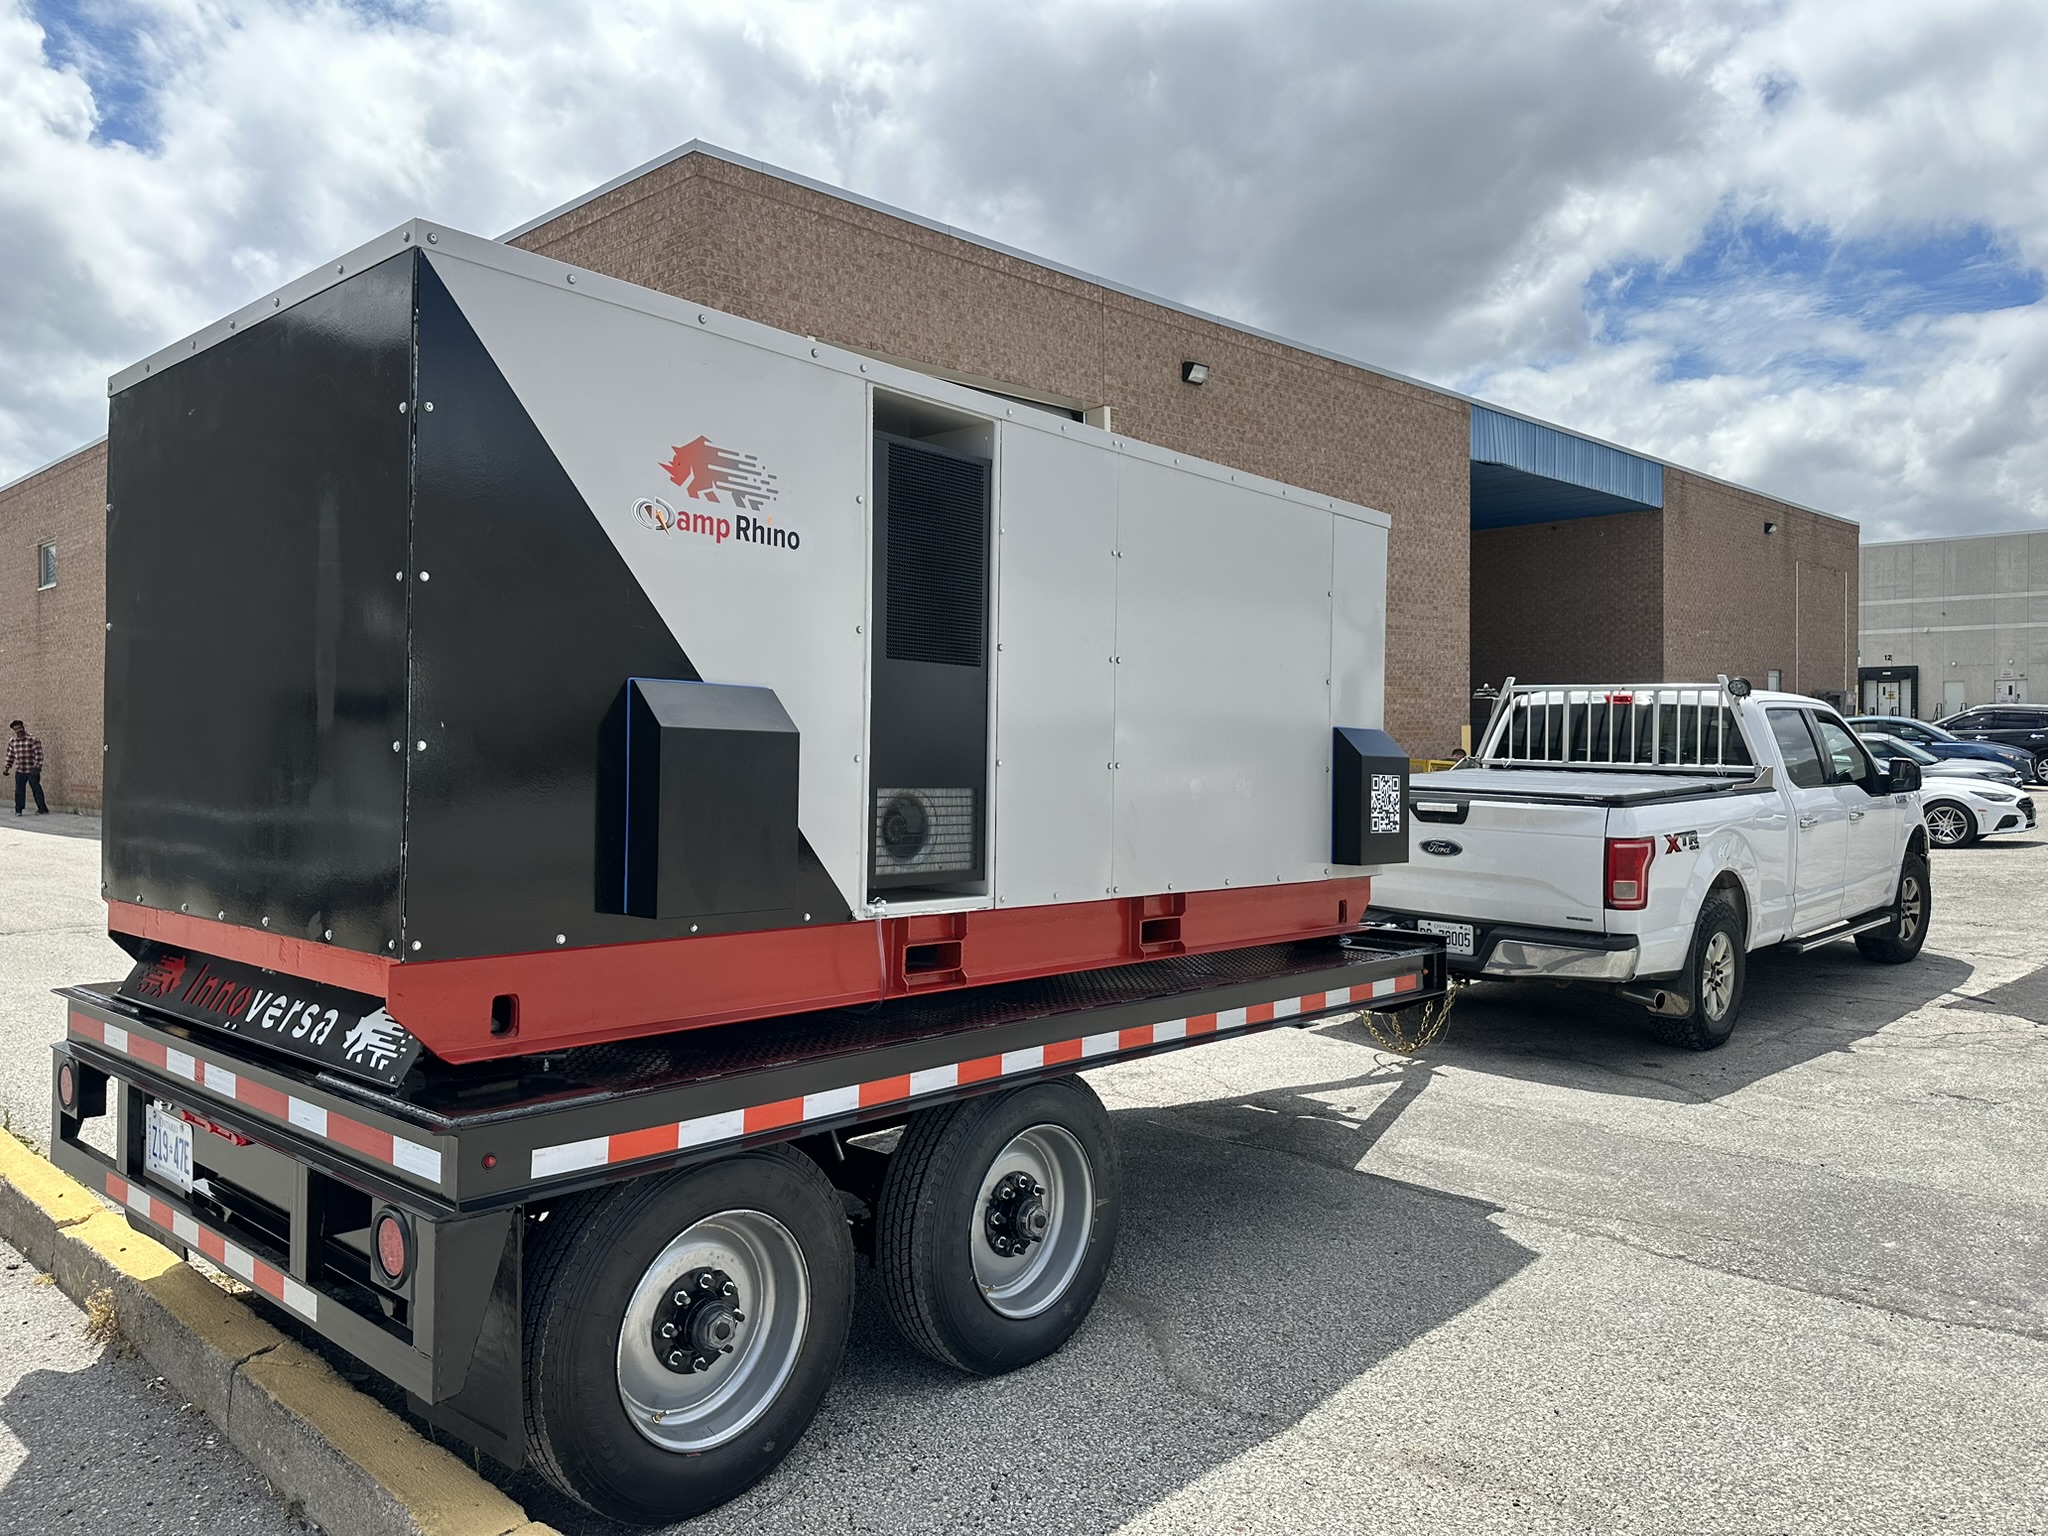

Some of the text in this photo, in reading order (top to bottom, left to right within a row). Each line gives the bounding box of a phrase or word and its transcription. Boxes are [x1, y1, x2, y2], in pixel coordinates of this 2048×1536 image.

[735, 514, 801, 551] Rhino
[1427, 841, 1452, 854] Ford
[1663, 829, 1700, 855] XTR
